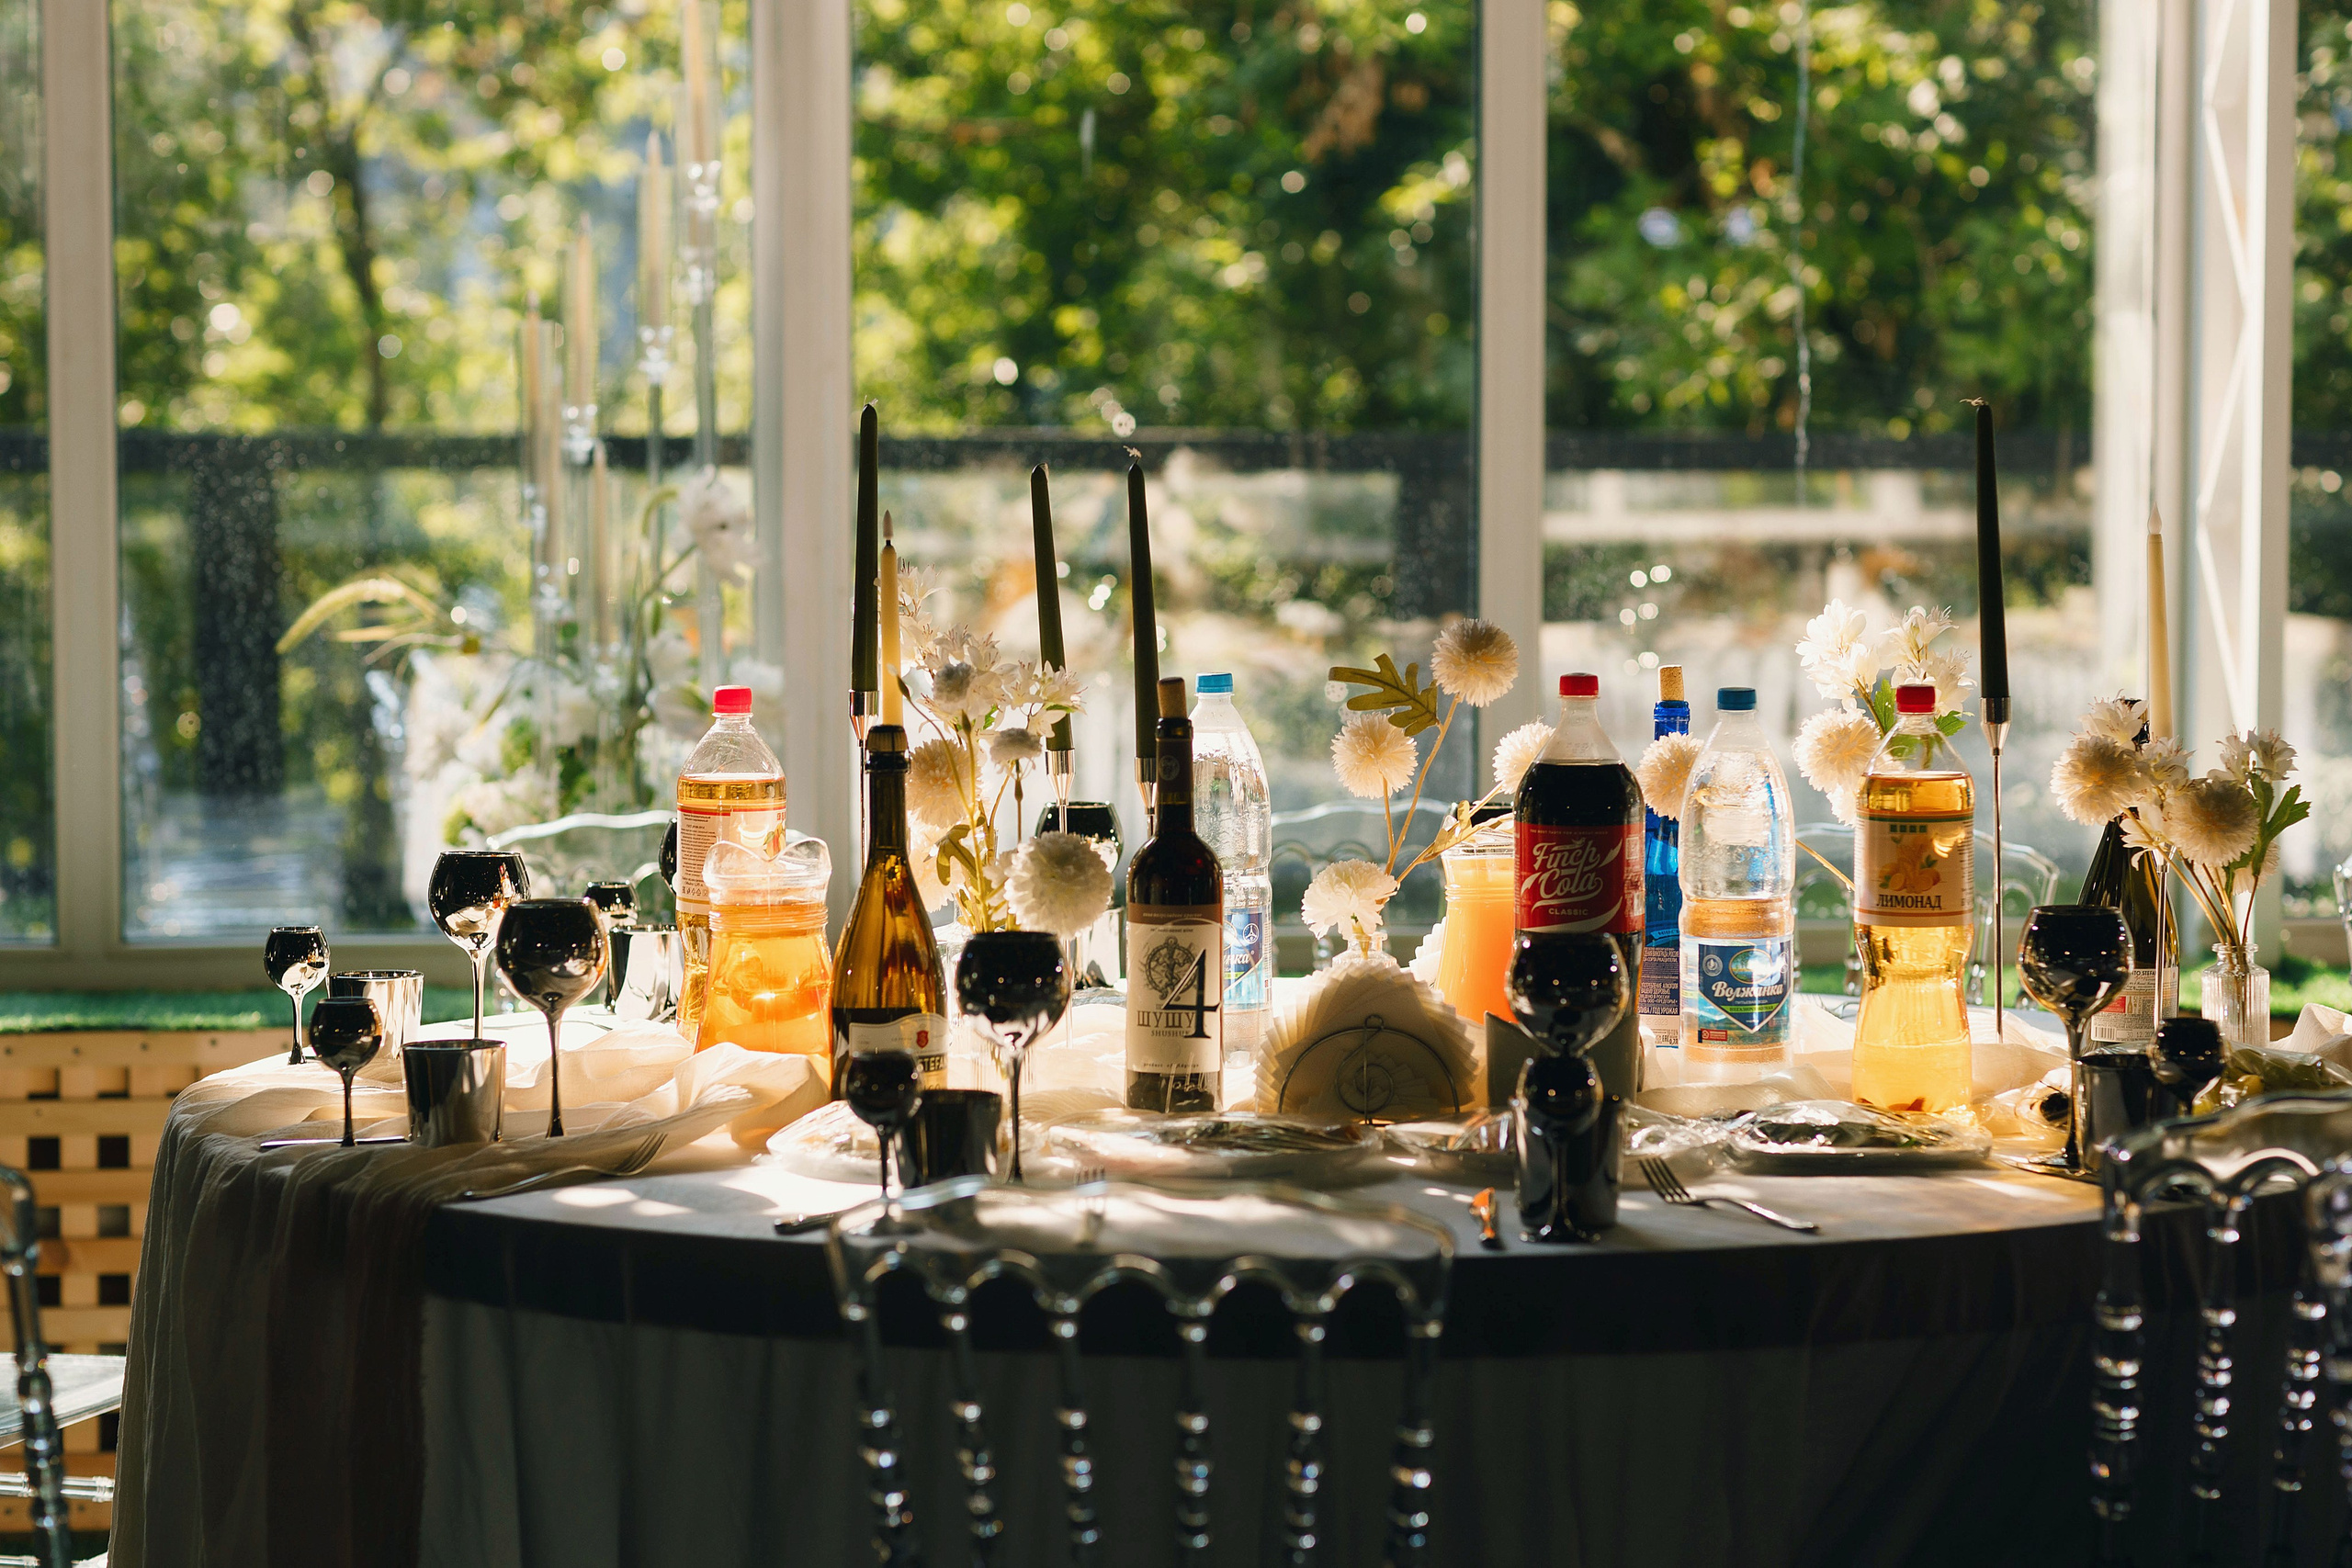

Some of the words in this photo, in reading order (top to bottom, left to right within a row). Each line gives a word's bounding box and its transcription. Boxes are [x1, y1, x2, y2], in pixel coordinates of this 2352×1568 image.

[1532, 839, 1600, 871] Finch
[1538, 868, 1602, 899] Cola
[1548, 908, 1589, 916] CLASSIC
[1876, 894, 1942, 910] ЛИМОНАД
[1161, 948, 1222, 1039] 4
[1712, 981, 1783, 1001] Волжанка
[1136, 1010, 1196, 1028] ШУШУ
